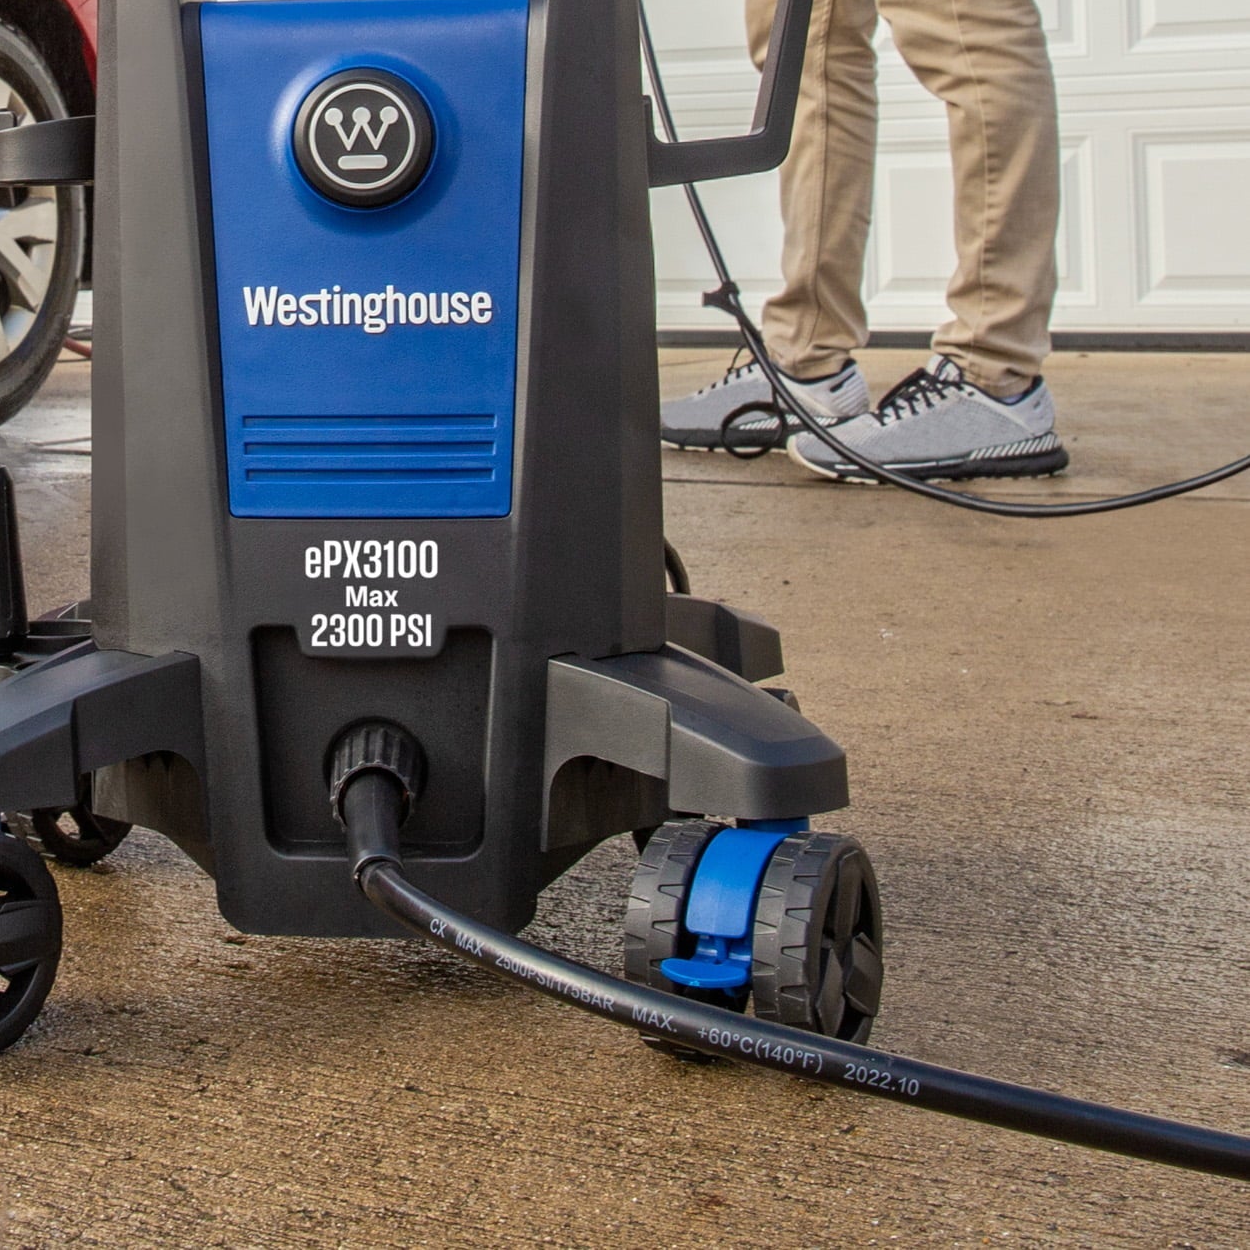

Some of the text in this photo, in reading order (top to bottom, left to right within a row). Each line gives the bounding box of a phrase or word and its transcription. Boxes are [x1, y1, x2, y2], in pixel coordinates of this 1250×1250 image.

[243, 285, 493, 334] Westinghouse
[304, 540, 438, 578] ePX3100
[345, 585, 398, 607] Max
[311, 613, 432, 647] 2300 PSI
[429, 918, 447, 938] CX
[455, 931, 484, 957] MAX
[631, 1004, 678, 1032] MAX.
[844, 1063, 920, 1096] 2022.10
